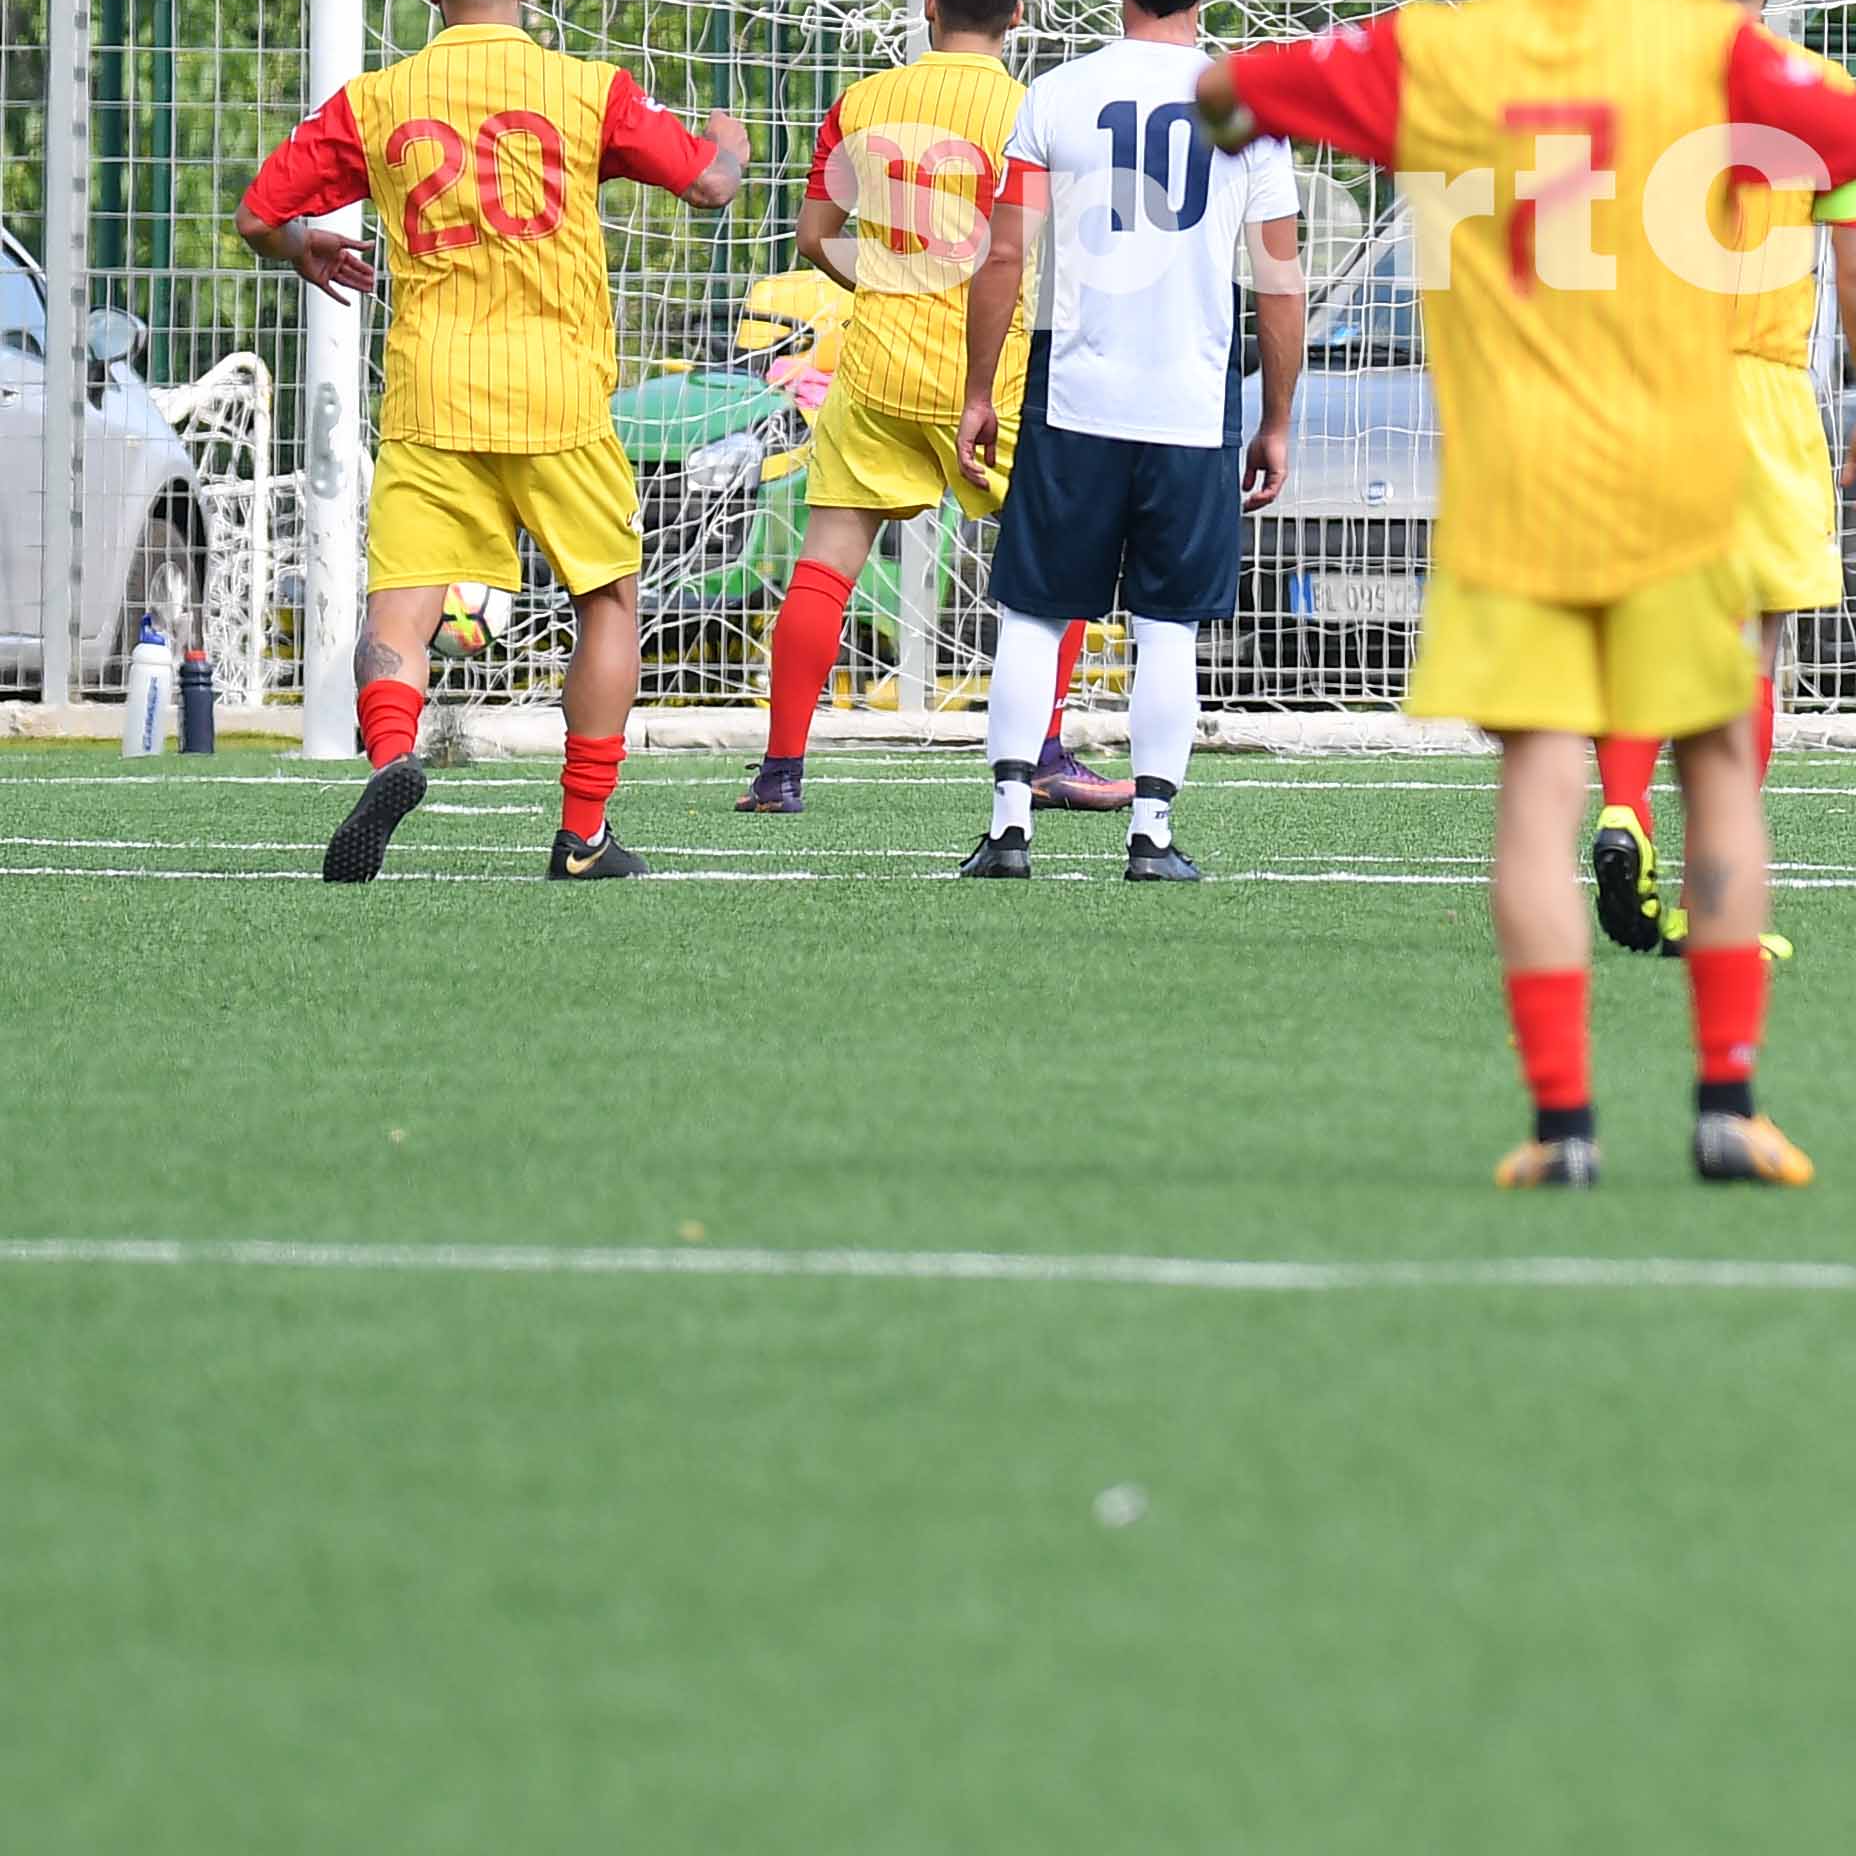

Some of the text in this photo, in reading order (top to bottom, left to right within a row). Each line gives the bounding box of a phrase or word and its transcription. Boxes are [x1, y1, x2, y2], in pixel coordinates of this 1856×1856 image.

[385, 110, 565, 257] 20
[867, 135, 993, 263] 10
[1097, 100, 1214, 232] 10
[1503, 101, 1619, 297] 7
